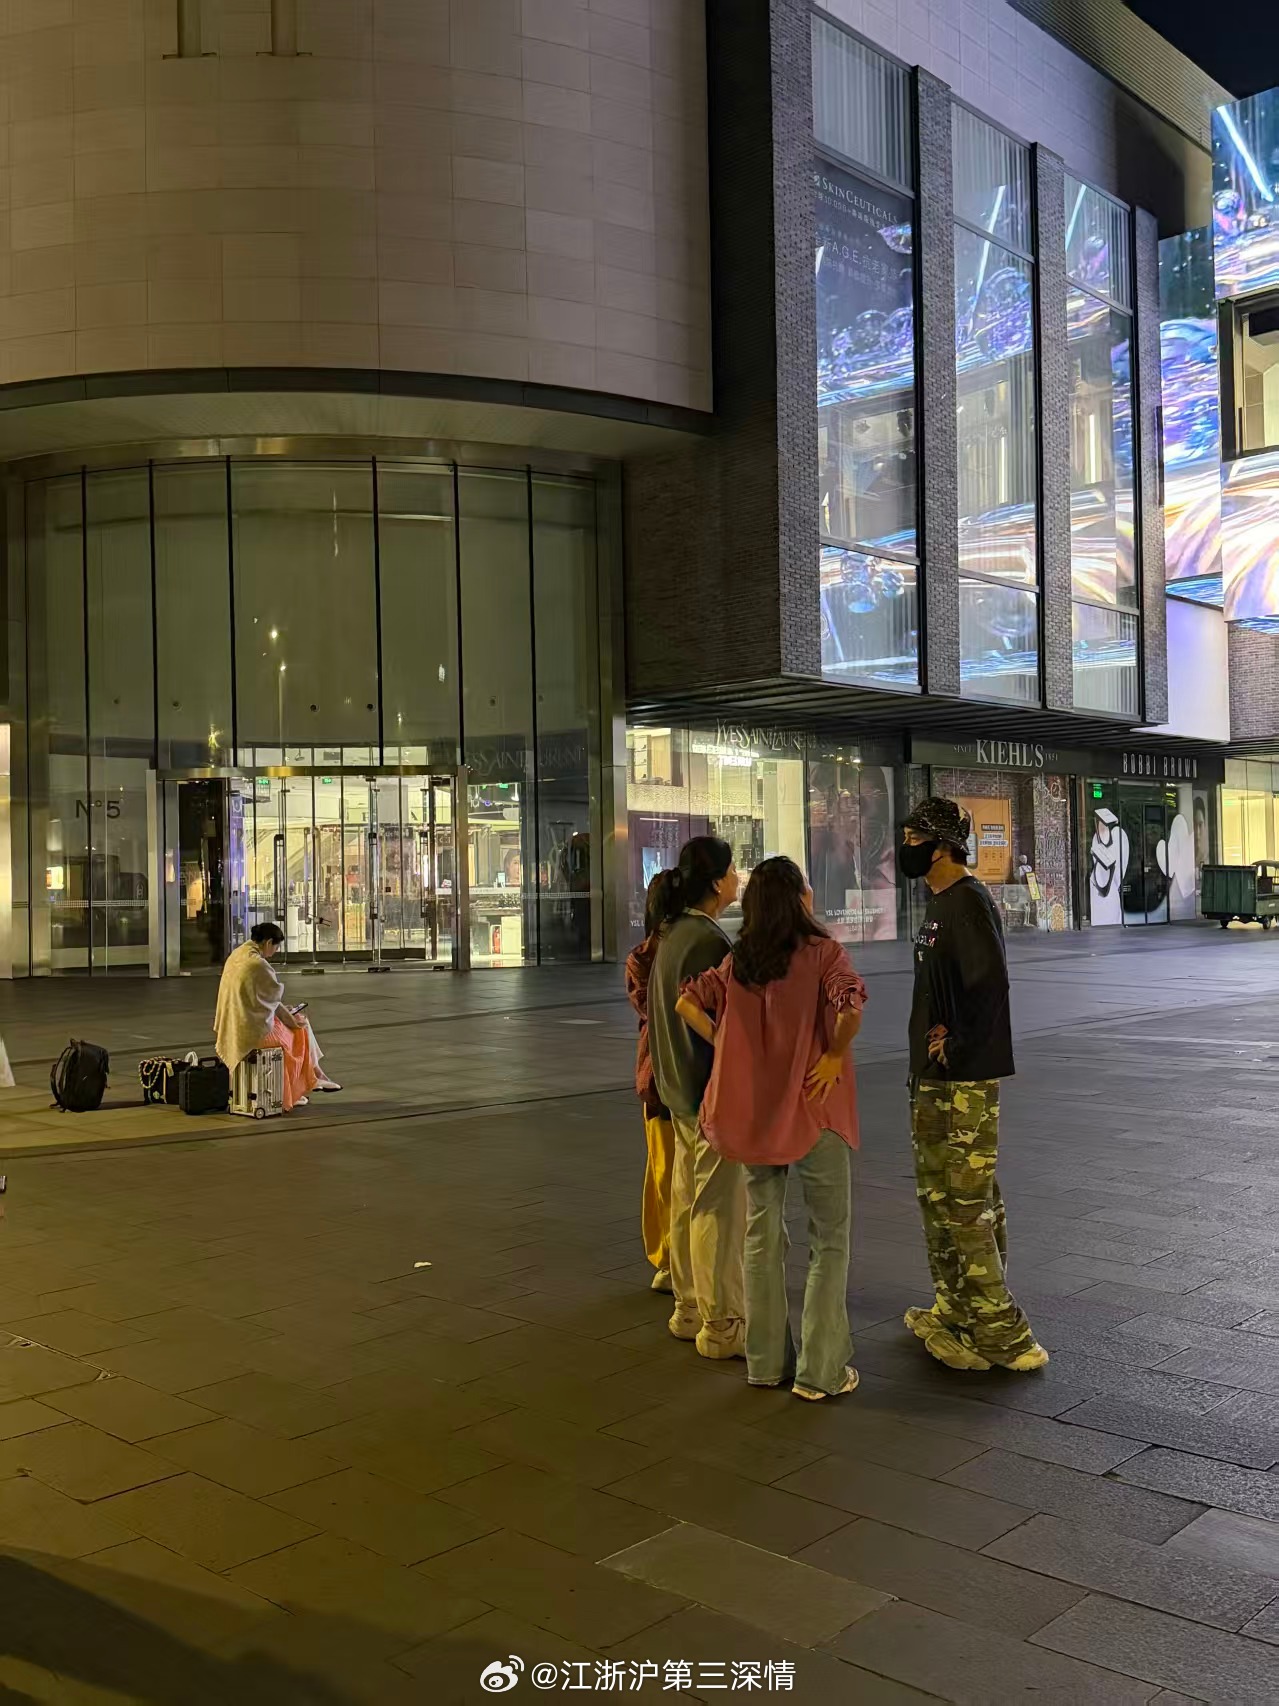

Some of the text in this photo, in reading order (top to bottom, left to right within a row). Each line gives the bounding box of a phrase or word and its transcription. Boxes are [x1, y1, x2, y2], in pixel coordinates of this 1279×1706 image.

[716, 718, 744, 748] YVES
[738, 724, 774, 749] SAINT
[975, 739, 1044, 768] KIEHL'S
[1122, 752, 1198, 779] BOBBI BROWN
